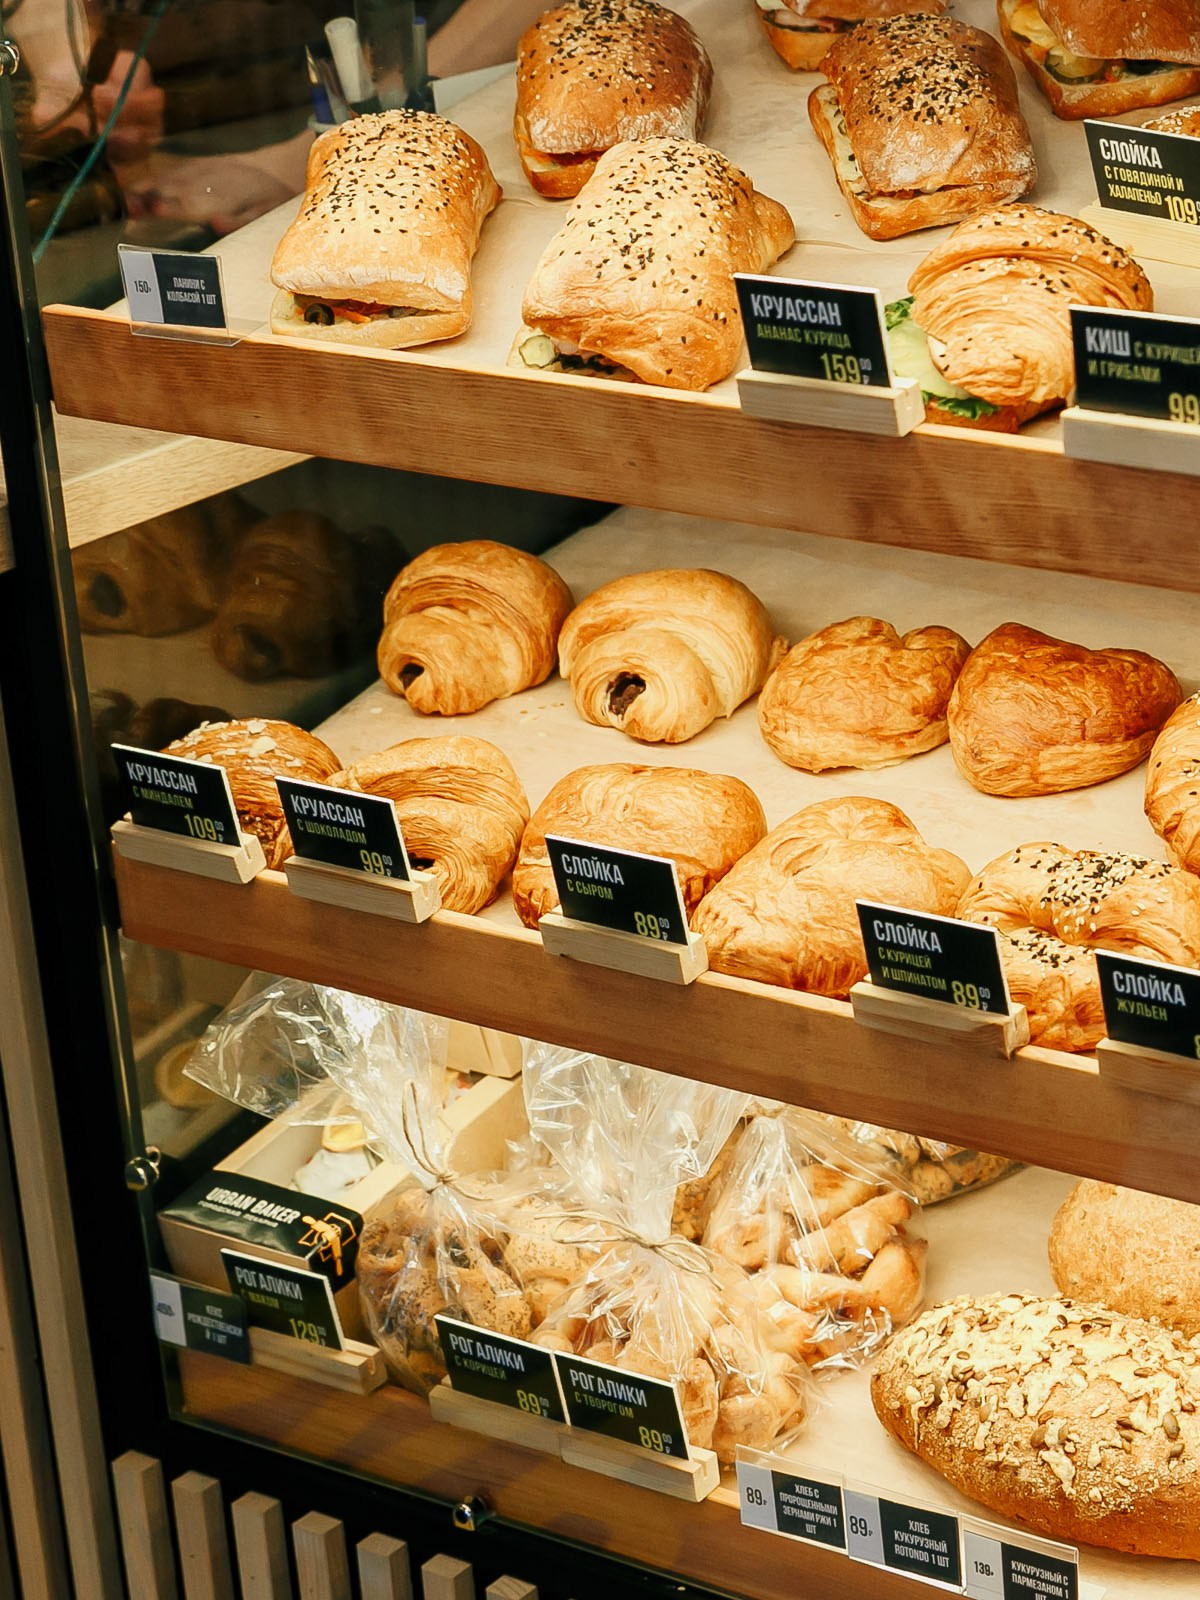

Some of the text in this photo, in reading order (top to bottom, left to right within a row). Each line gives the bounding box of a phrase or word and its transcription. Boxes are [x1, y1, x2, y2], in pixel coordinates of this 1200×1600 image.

[1099, 138, 1163, 169] СЛОЙКА
[1104, 165, 1185, 192] С ГОВЯДИНОЙ И
[1108, 184, 1163, 206] ХАЛАПЕНЬО
[1164, 195, 1199, 225] 109
[166, 290, 217, 305] КОЛБАСОЙ 1 ШТ
[200, 279, 206, 290] С
[750, 293, 842, 326] КРУАССАН
[757, 323, 852, 349] АНАНАС КУРИЦА
[1085, 326, 1131, 357] КИШ
[1133, 341, 1144, 358] С
[820, 352, 862, 384] 159
[1088, 359, 1162, 384] И ГРИБАМИ
[1168, 392, 1200, 425] 99
[126, 761, 199, 795] КРУАССАН
[132, 785, 194, 810] С МИНДАЛЕМ
[290, 794, 366, 829] КРУАССАН
[184, 813, 217, 841] 109
[296, 818, 368, 845] С ШОКОЛАДОМ
[360, 848, 385, 876] 99
[561, 853, 625, 886] СЛОЙКА
[566, 878, 614, 901] С СЫРОМ
[633, 911, 662, 940] 89
[873, 919, 943, 954] СЛОЙКА
[877, 946, 932, 969] С КУРИЦЕЙ
[881, 965, 947, 991] И ШПИНАТОМ
[1112, 970, 1187, 1007] СЛОЙКА
[951, 980, 980, 1010] 89
[1116, 998, 1168, 1022] ЖУЛЬЕН
[205, 1186, 302, 1225] URBAN BAKER
[234, 1265, 304, 1301] РОГАЛИКИ
[288, 1318, 320, 1345] 129
[448, 1332, 525, 1373] РОГАЛИКИ
[454, 1355, 508, 1381] С КОРИЦЕЙ
[569, 1368, 648, 1408] РОГАЛИКИ
[516, 1389, 541, 1415] 89
[574, 1391, 635, 1419] С ТВОРОГОМ
[638, 1425, 664, 1453] 89
[779, 1491, 838, 1516] ПРОРОЩЕННЫМИ
[794, 1483, 820, 1499] ХЛЕБ С
[782, 1505, 837, 1528] ЗЕРНАМИ РЖИ 1
[805, 1523, 817, 1535] ШТ
[908, 1519, 930, 1535] ХЛЕБ
[893, 1529, 948, 1554] КУКУРУЗНЫЙ
[894, 1543, 950, 1569] ROTONDO 1 ШТ
[1010, 1559, 1069, 1586] КУКУРУЗНЫЙ С
[1011, 1573, 1069, 1600] ПАРМЕЗАНОМ 1
